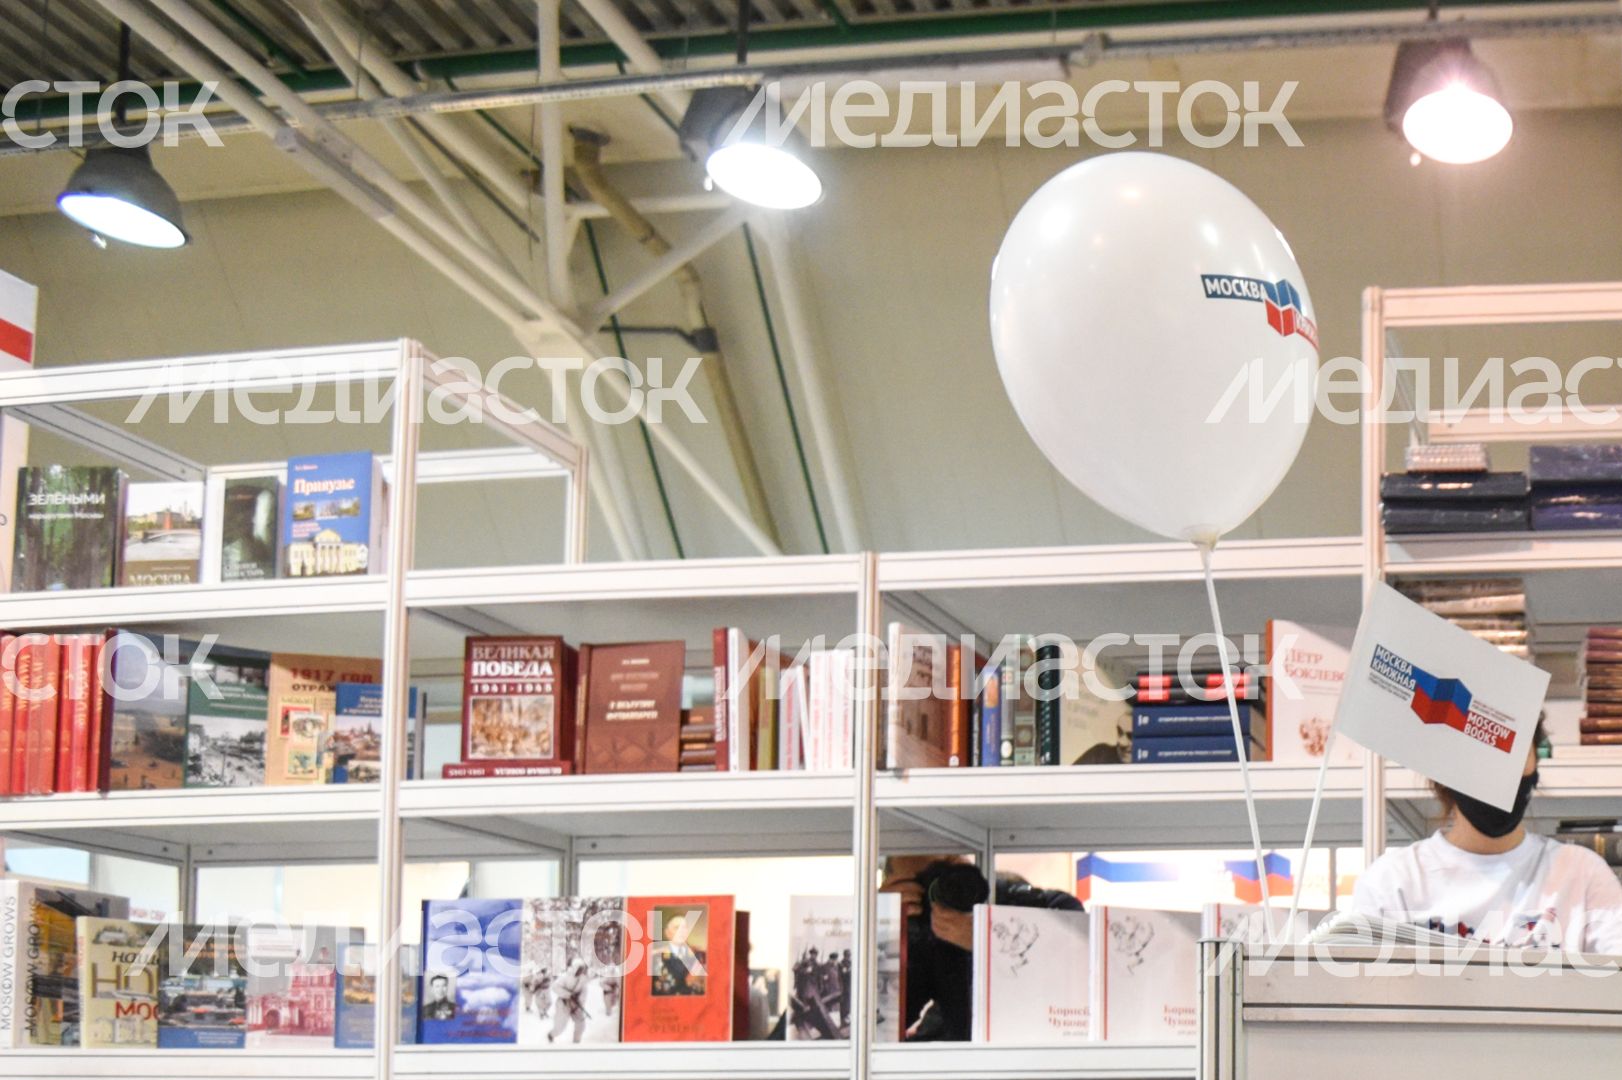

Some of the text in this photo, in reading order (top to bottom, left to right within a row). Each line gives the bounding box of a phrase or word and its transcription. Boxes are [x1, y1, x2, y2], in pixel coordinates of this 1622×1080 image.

[1204, 278, 1269, 301] МОСКВА
[128, 573, 192, 585] МОСКВА
[472, 645, 555, 660] ВЕЛИКАЯ
[1374, 645, 1414, 676] МОСКВА
[291, 668, 374, 684] 1917 год
[471, 660, 554, 677] ПОБЕДА
[1371, 658, 1417, 691] КНИЖНАЯ
[1463, 722, 1498, 747] BOOKS
[1467, 710, 1512, 741] MOSCOW
[1, 896, 16, 1031] MOSCOW GROWS
